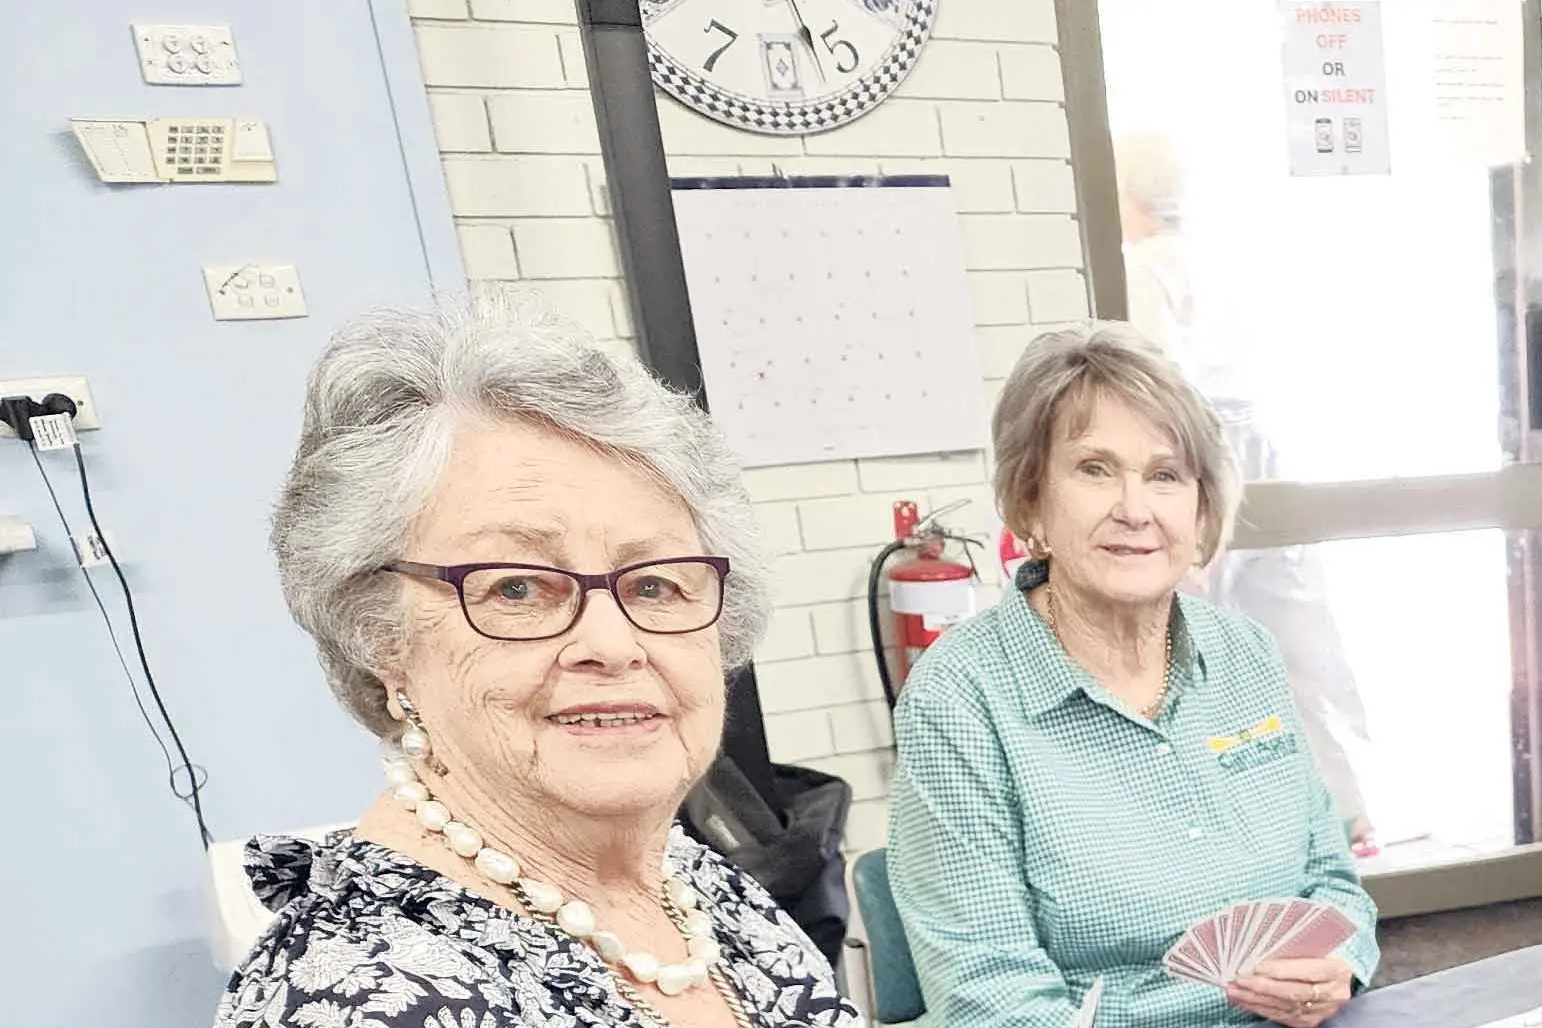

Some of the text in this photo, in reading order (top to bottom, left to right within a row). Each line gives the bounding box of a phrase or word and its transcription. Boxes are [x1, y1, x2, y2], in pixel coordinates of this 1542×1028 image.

[1295, 8, 1362, 23] PHONES
[1316, 33, 1347, 50] OFF
[1322, 61, 1346, 77] OR
[1294, 88, 1376, 105] ON SILENT
